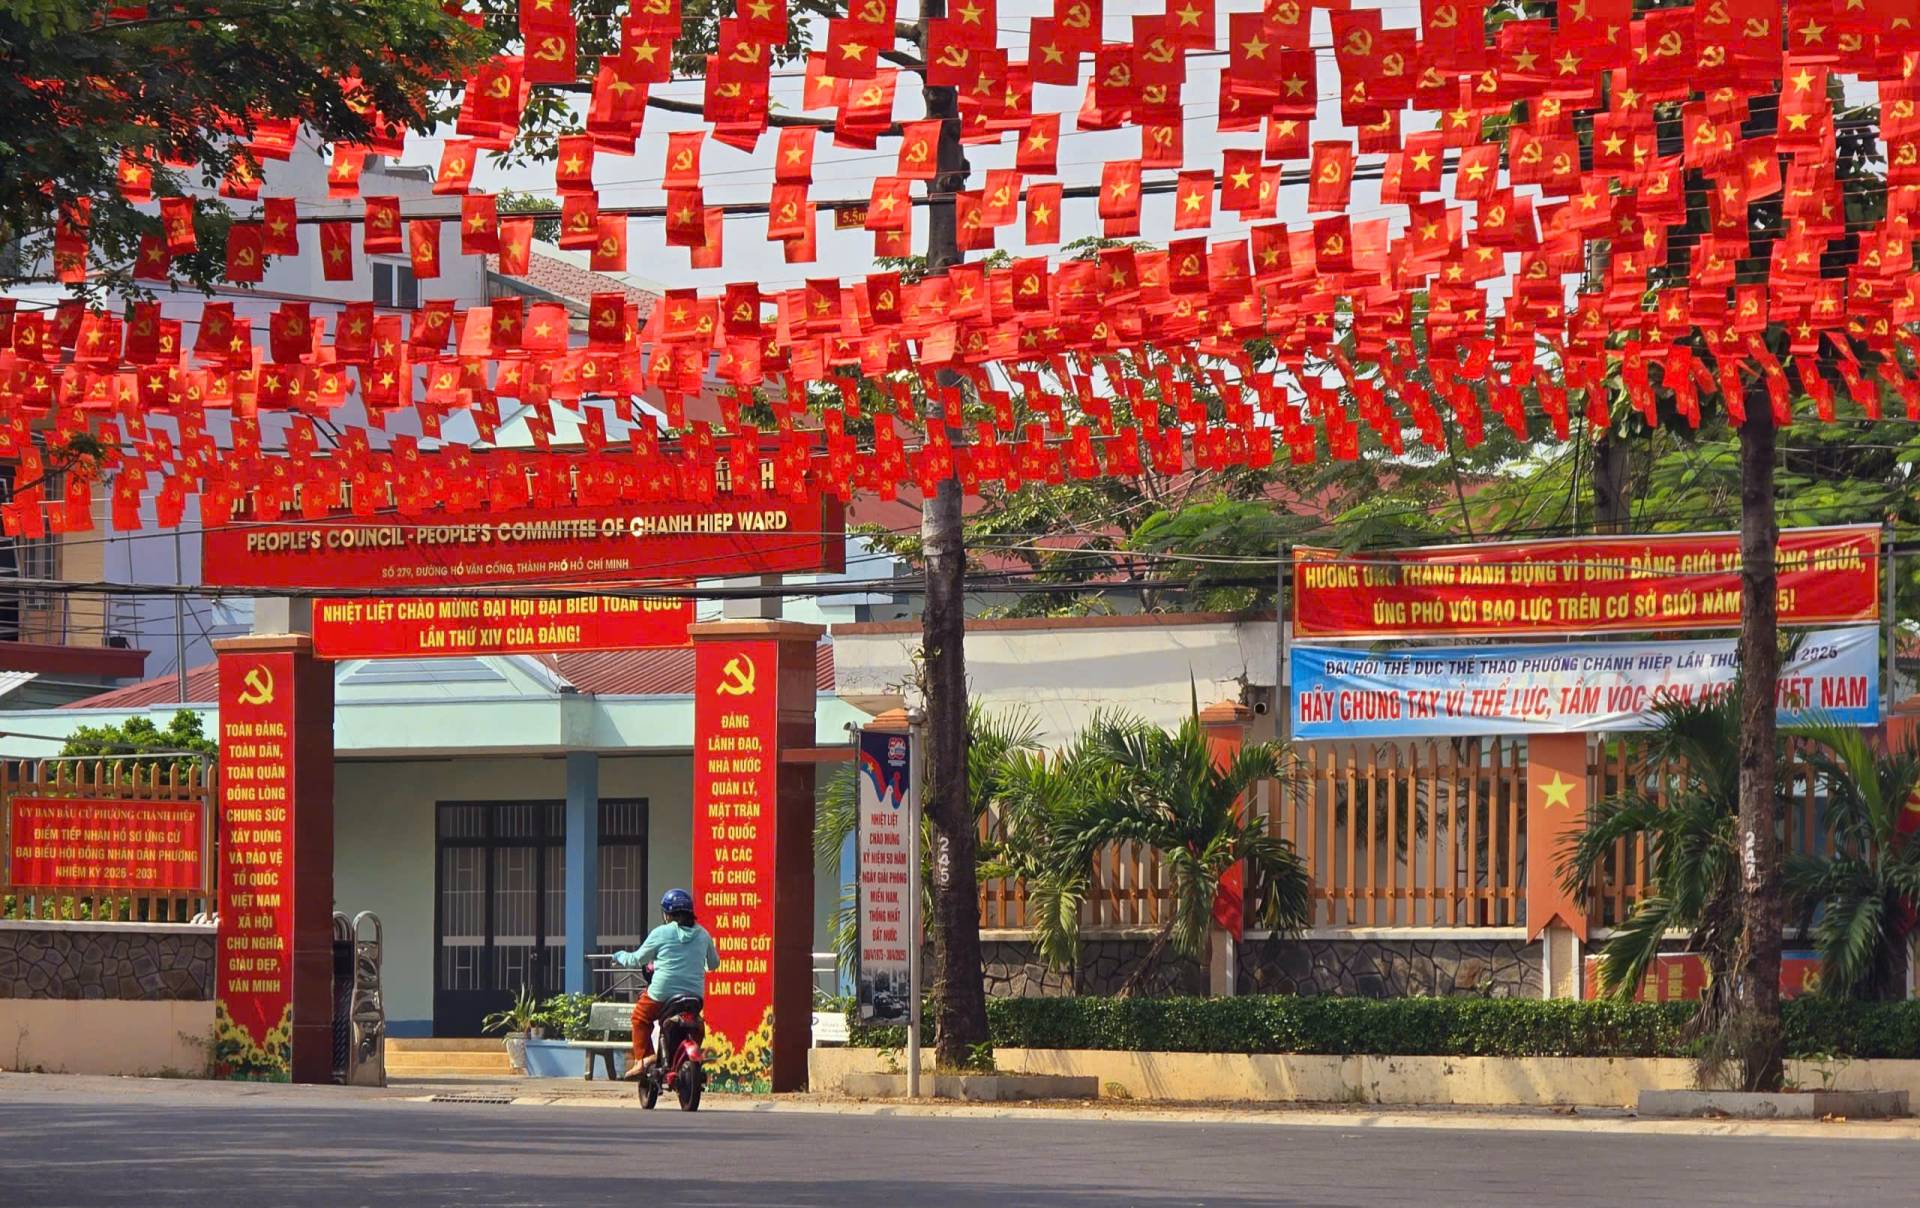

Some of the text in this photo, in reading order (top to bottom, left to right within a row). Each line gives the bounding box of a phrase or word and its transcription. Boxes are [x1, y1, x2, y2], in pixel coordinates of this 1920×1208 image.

[247, 511, 787, 551] PEOPLE'S COUNCIL PEOPLE'S COMMITTEE OF CHANH HIEP WARD
[397, 566, 413, 578] 279,
[416, 564, 448, 577] ĐƯỜNG
[466, 563, 483, 575] VĂN
[517, 561, 546, 573] THÀNH
[549, 557, 568, 571] PHỐ
[570, 556, 583, 570] HỒ
[587, 559, 603, 570] CHÍ
[606, 559, 629, 570] MINH
[1460, 558, 1505, 584] HÀNH
[1511, 556, 1557, 588] ĐỘNG
[1563, 554, 1579, 581] VÌ
[1584, 554, 1624, 581] BÌNH
[1630, 547, 1675, 578] ĐẲNG
[1681, 549, 1716, 574] GIỚI
[323, 601, 362, 625] NHIỆT
[366, 600, 394, 623] LIỆT
[398, 599, 434, 620] CHÀO
[439, 598, 479, 618] MỪNG
[483, 600, 506, 620] ĐẠI
[539, 599, 561, 618] ĐẠI
[1374, 588, 1741, 626] ỨNG PHÓ VỚI BẠO LỰC TRÊN CƠ SỞ GIỚI NĂM
[420, 622, 581, 647] LẦN THỨ XIV CỦA ĐẢNG!
[1325, 660, 1349, 677] ĐẠI
[1384, 655, 1412, 674] THỂ
[1414, 660, 1444, 678] DỤC
[1449, 655, 1476, 674] THỂ
[1480, 660, 1517, 674] THAO
[1521, 655, 1579, 673] PHƯỜNG
[1583, 655, 1634, 671] CHÁNH
[1638, 653, 1673, 672] HIỆP
[1676, 650, 1704, 668] LẦN
[1300, 684, 1335, 723] HÃY
[1339, 690, 1401, 721] CHUNG
[1406, 689, 1441, 719] TAY
[1445, 684, 1467, 718] VÌ
[1470, 677, 1511, 718] THỂ
[1510, 683, 1553, 723] LỰC,
[1560, 675, 1602, 715] TẦM
[1607, 680, 1647, 714] VÓC
[1821, 676, 1867, 708] NAM
[225, 720, 287, 738] TOÀN ĐẢNG,
[721, 711, 749, 729] ĐẢNG
[228, 742, 283, 759] TOÀN DÂN,
[708, 734, 762, 753] LÃNH ĐẠO,
[227, 763, 285, 780] TOÀN QUÂN
[708, 756, 761, 773] NHÀ NƯỚC
[258, 784, 286, 801] LÒNG
[712, 778, 758, 797] QUẢN LÝ,
[226, 807, 286, 822] CHUNG SỨC
[708, 801, 760, 820] MẶT TRẬN
[231, 827, 282, 845] XÂY DỰNG
[728, 821, 757, 840] QUỐC
[229, 847, 283, 867] VÀ BẢO VỆ
[715, 845, 752, 862] VÀ CÁC
[940, 837, 950, 882] 245
[249, 868, 279, 886] QUỐC
[727, 867, 756, 884] CHỨC
[231, 892, 280, 910] VIỆT NAM
[705, 890, 762, 910] CHÍNH TRỊ-
[238, 912, 273, 931] XÃ HỘI
[716, 912, 750, 931] XÃ HỘI
[227, 934, 284, 950] CHỦ NGHĨA
[720, 934, 747, 951] NÒNG
[751, 933, 771, 951] CỐT
[256, 958, 280, 973] ĐẸP,
[746, 956, 767, 973] DÂN
[228, 978, 280, 993] VĂN MINH
[709, 978, 756, 995] LÀM CHỦ
